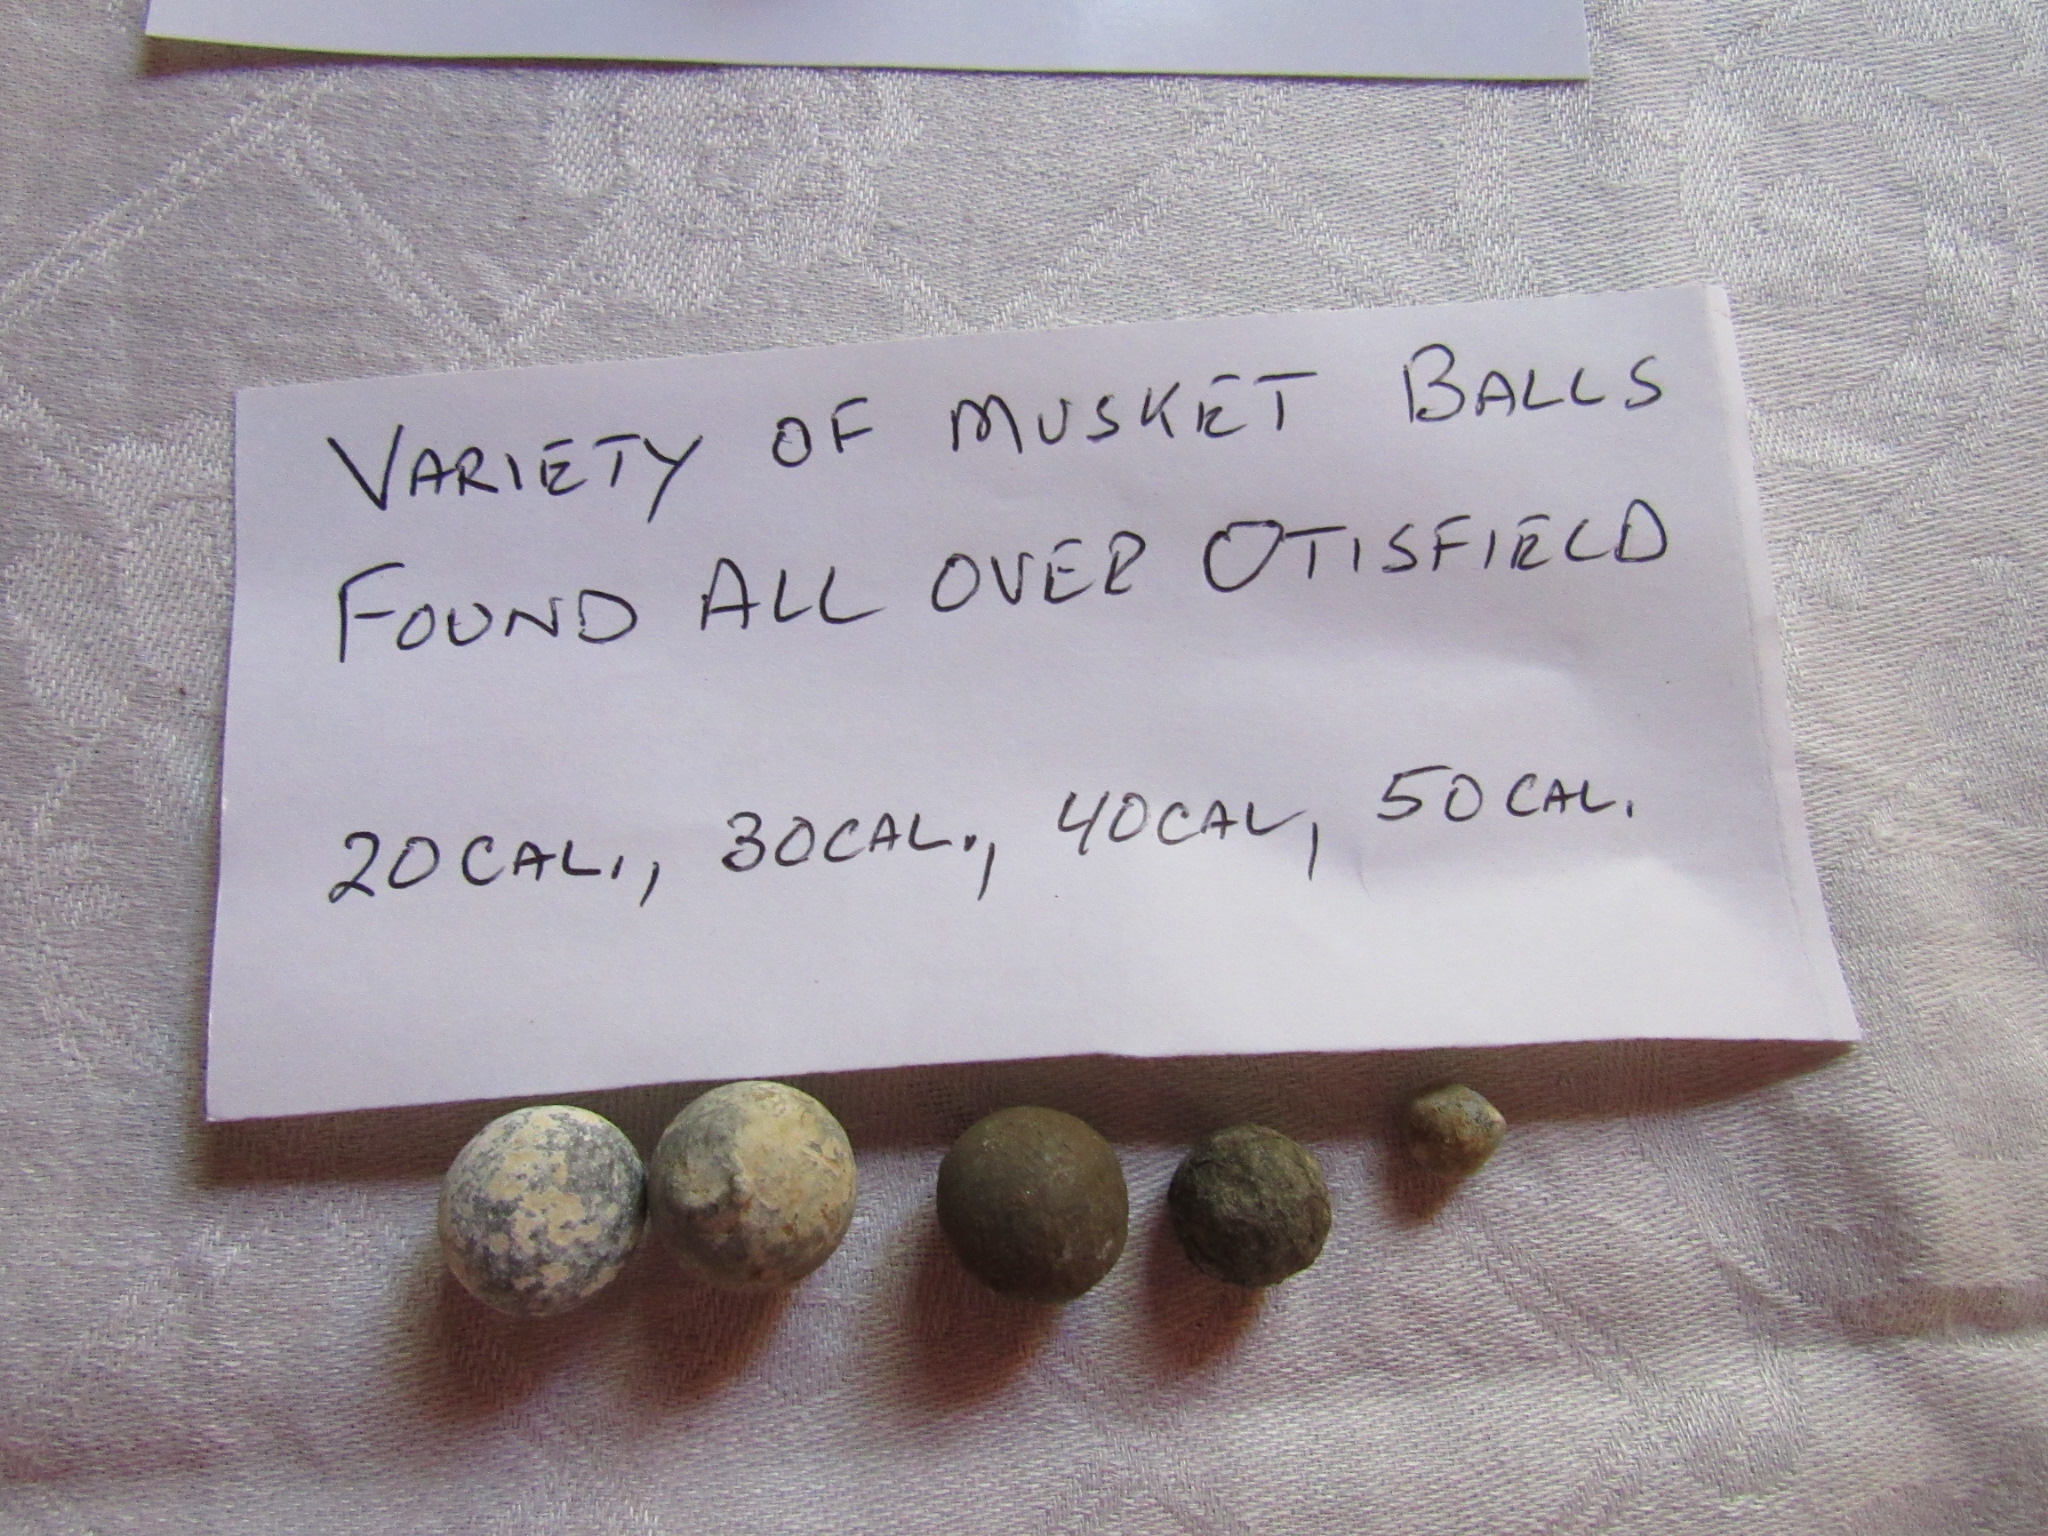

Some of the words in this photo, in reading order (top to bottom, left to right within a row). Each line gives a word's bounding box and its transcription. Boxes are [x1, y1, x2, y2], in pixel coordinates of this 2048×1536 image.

[326, 423, 704, 524] VARIETY
[771, 396, 874, 469] OF
[950, 371, 1318, 455] MUSKET
[1402, 343, 1667, 424] BALLS
[337, 561, 639, 664] FOUND
[700, 557, 885, 631] ALL
[930, 530, 1147, 613] OVER
[1202, 498, 1668, 594] OTISFIELD
